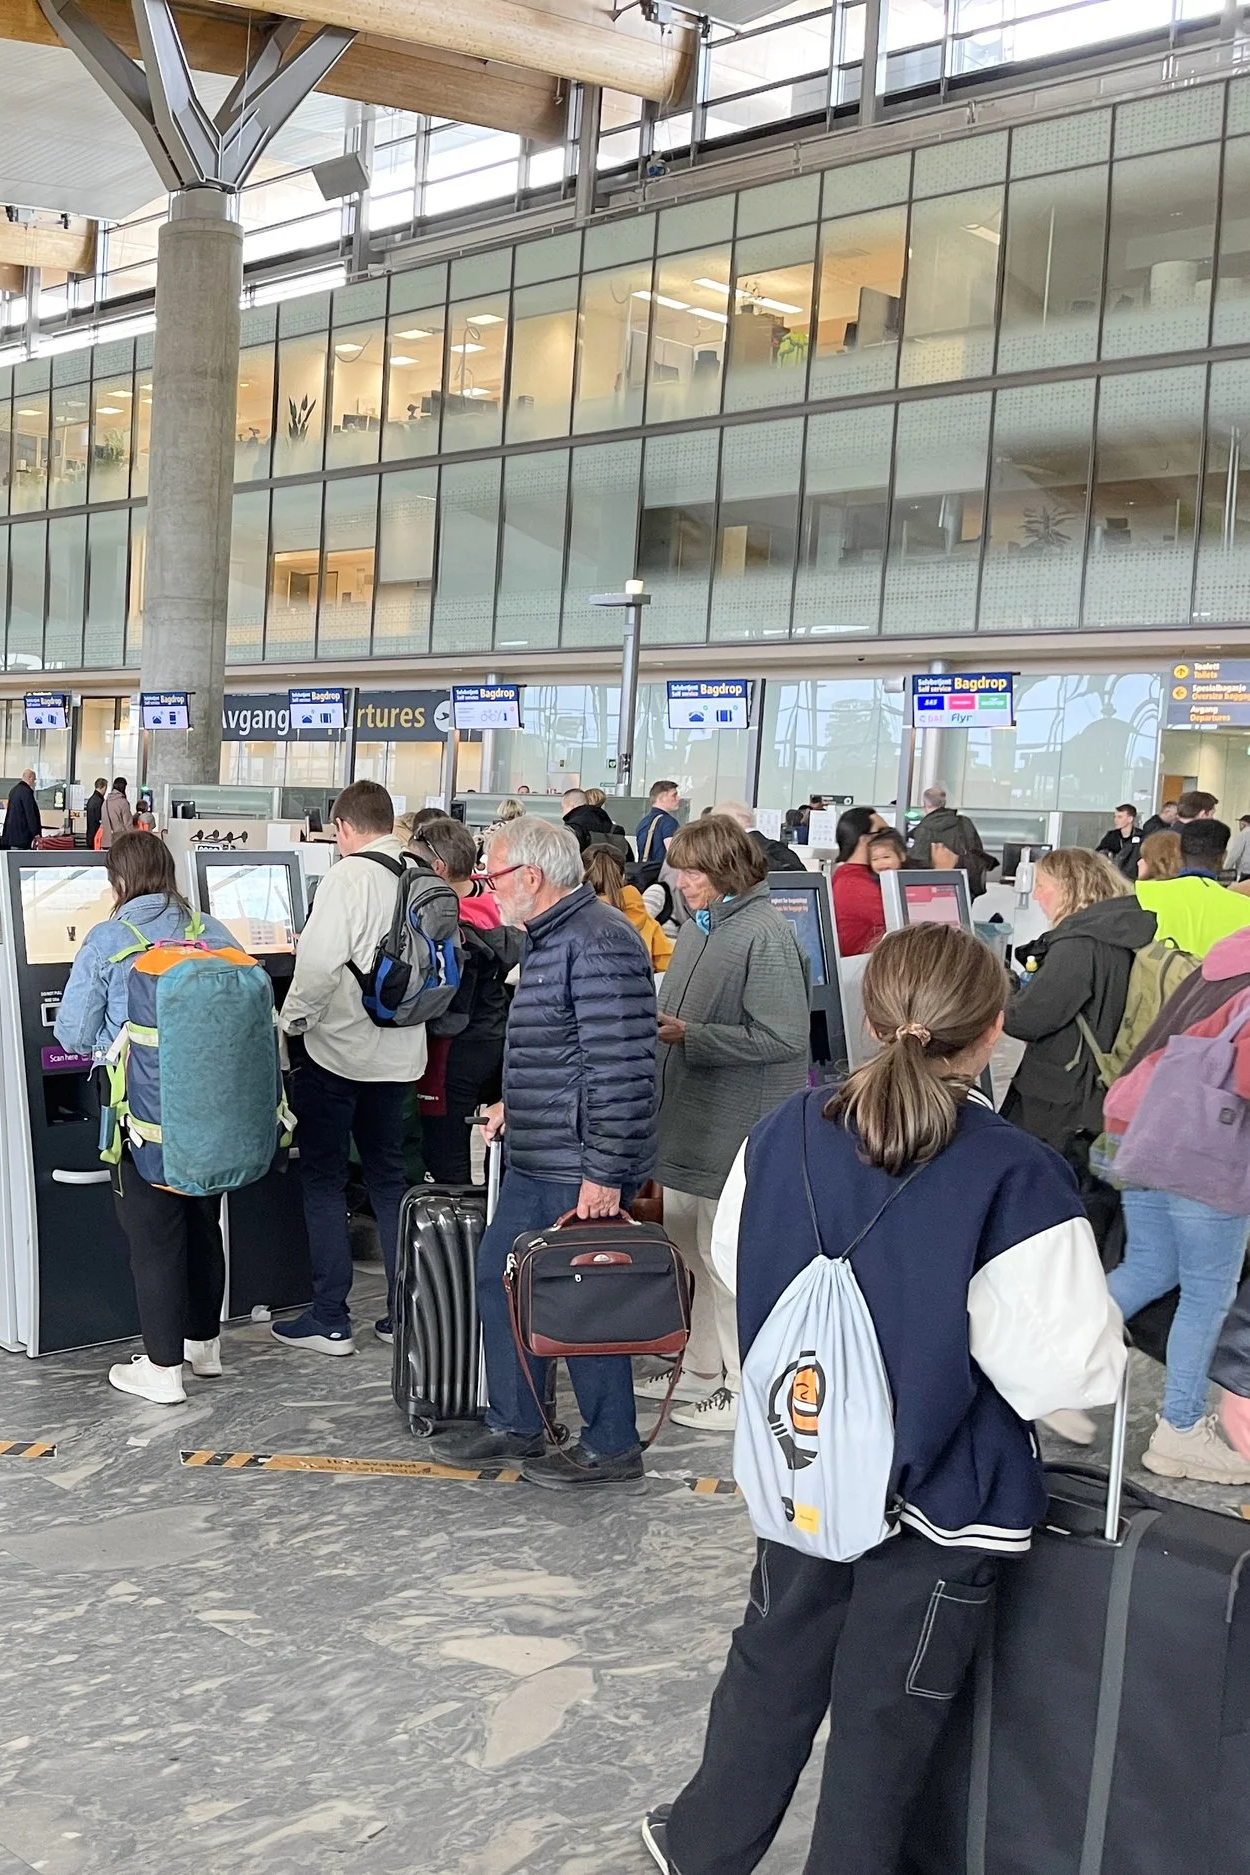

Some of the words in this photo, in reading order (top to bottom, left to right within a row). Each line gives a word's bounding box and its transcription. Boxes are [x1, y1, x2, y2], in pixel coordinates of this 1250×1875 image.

[701, 683, 742, 696] Bagdrop
[954, 675, 1007, 692] Bagdrop
[311, 690, 340, 702] Bagdrop
[479, 687, 515, 700] Bagdrop
[951, 712, 972, 723] Flyr
[50, 1054, 65, 1063] Scan
[65, 1053, 79, 1061] here
